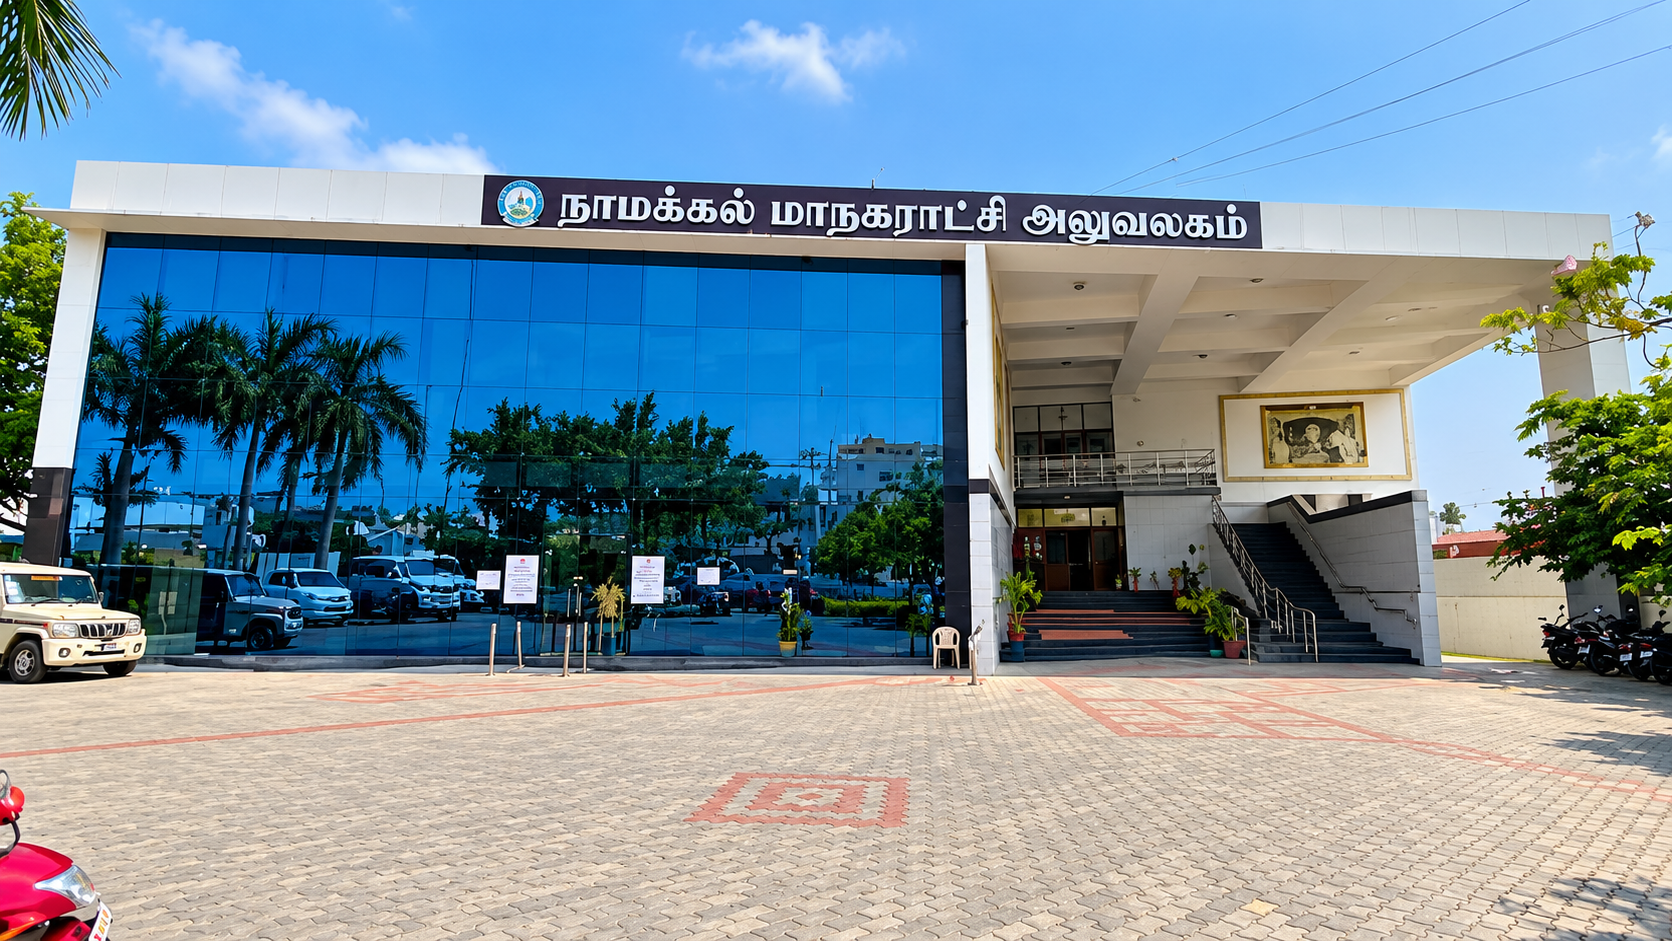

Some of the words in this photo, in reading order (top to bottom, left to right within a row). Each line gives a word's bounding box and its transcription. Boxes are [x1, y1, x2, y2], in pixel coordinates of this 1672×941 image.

[557, 185, 756, 228] நாமக்கல்
[770, 195, 1007, 237] மாநகராட்சி
[1022, 203, 1249, 245] அலுவலகம்
